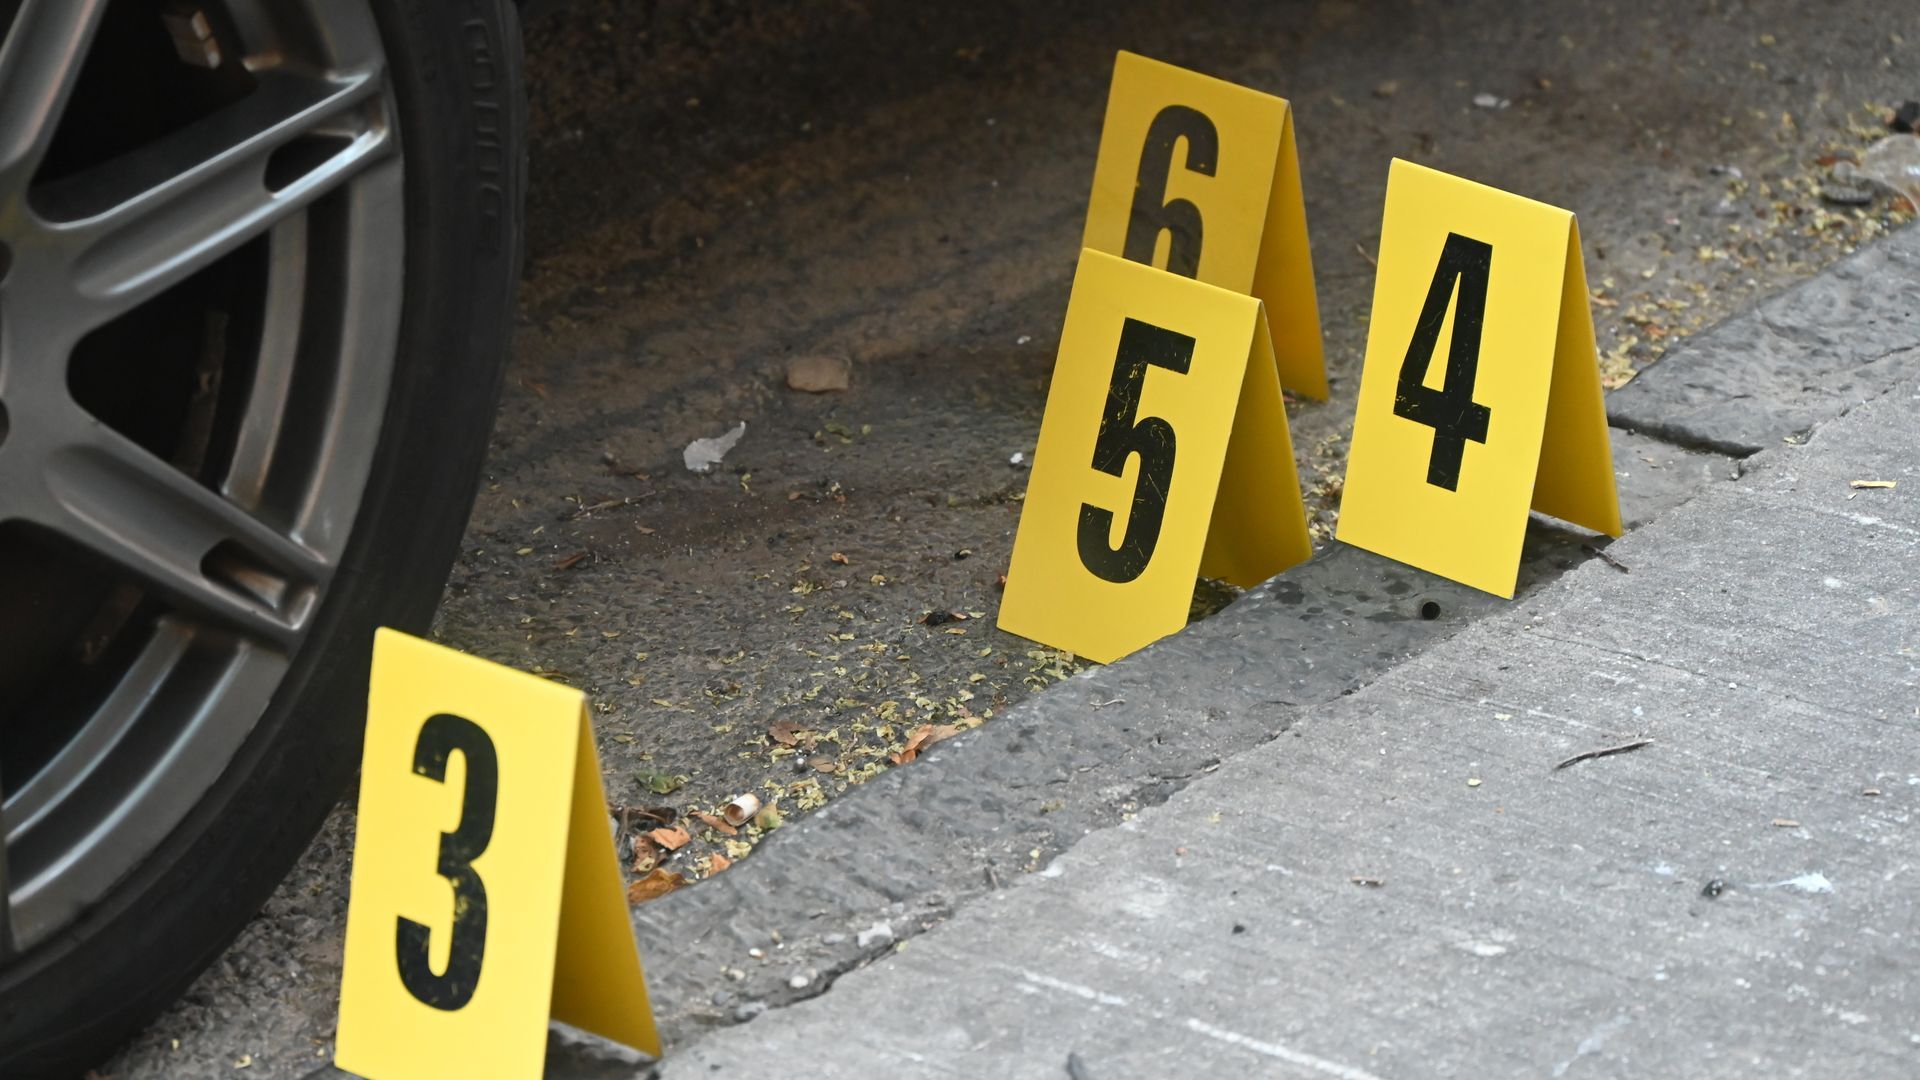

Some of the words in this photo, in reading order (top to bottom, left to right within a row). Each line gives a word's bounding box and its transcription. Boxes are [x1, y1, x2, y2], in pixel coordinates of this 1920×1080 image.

[1123, 105, 1218, 279] 6
[1077, 318, 1196, 583] 5
[1394, 232, 1493, 491] 4
[395, 713, 498, 1011] 3
